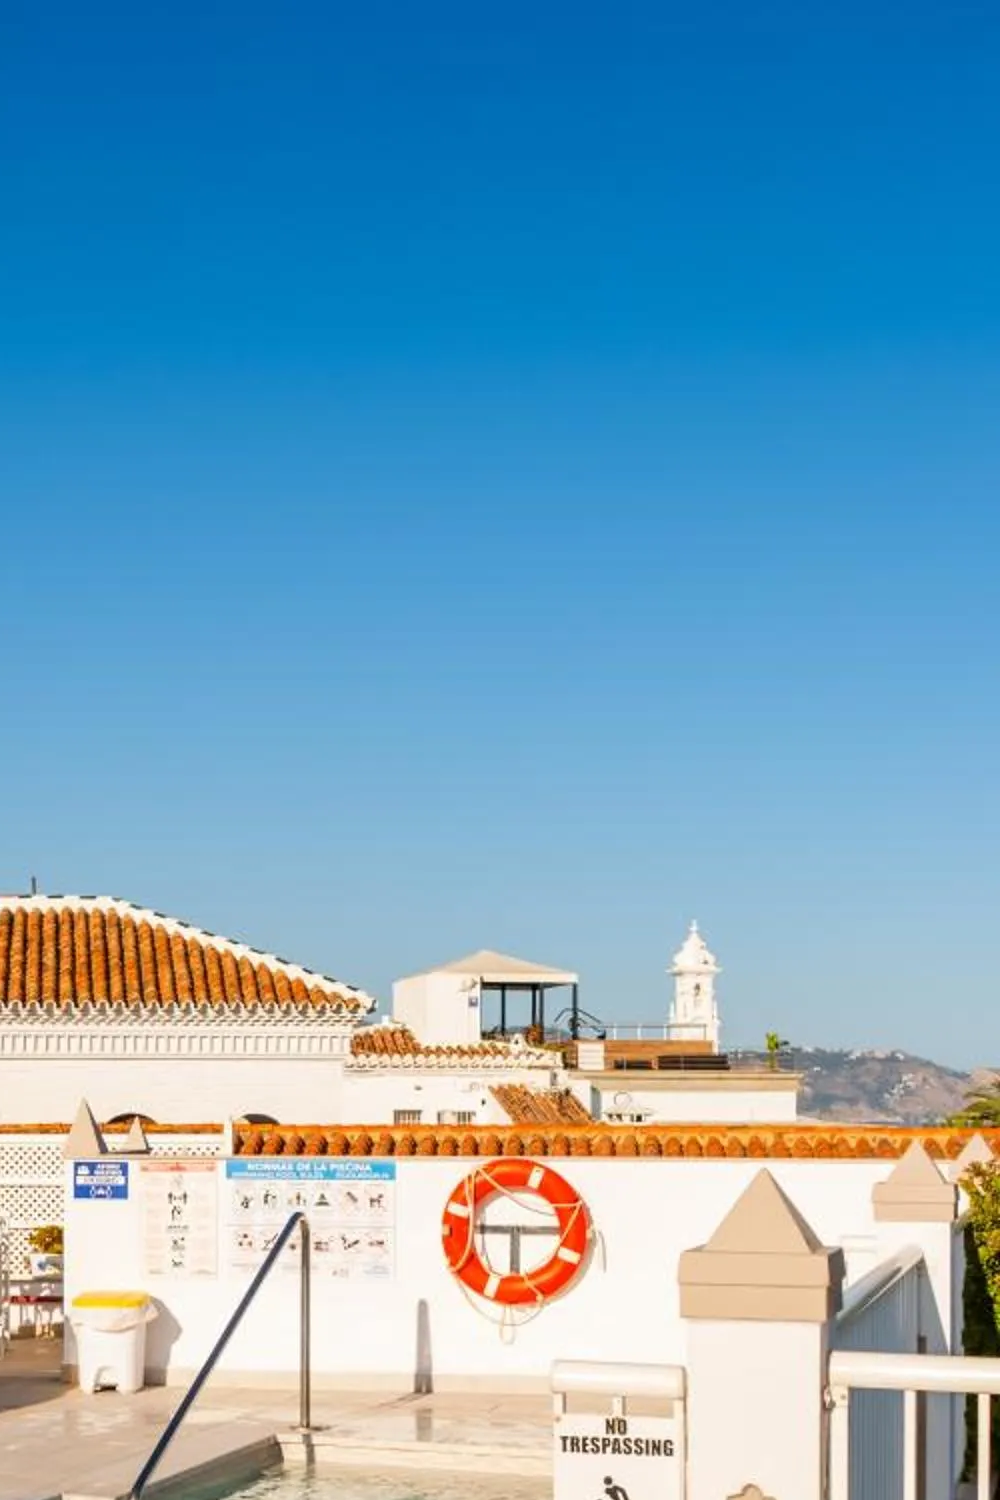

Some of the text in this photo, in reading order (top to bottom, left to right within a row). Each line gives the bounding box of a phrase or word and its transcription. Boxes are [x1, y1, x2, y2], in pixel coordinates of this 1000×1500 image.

[247, 1163, 372, 1171] NORMAS DE LA PISCINA
[605, 1417, 627, 1435] NO
[560, 1435, 674, 1456] TRESPASSING
